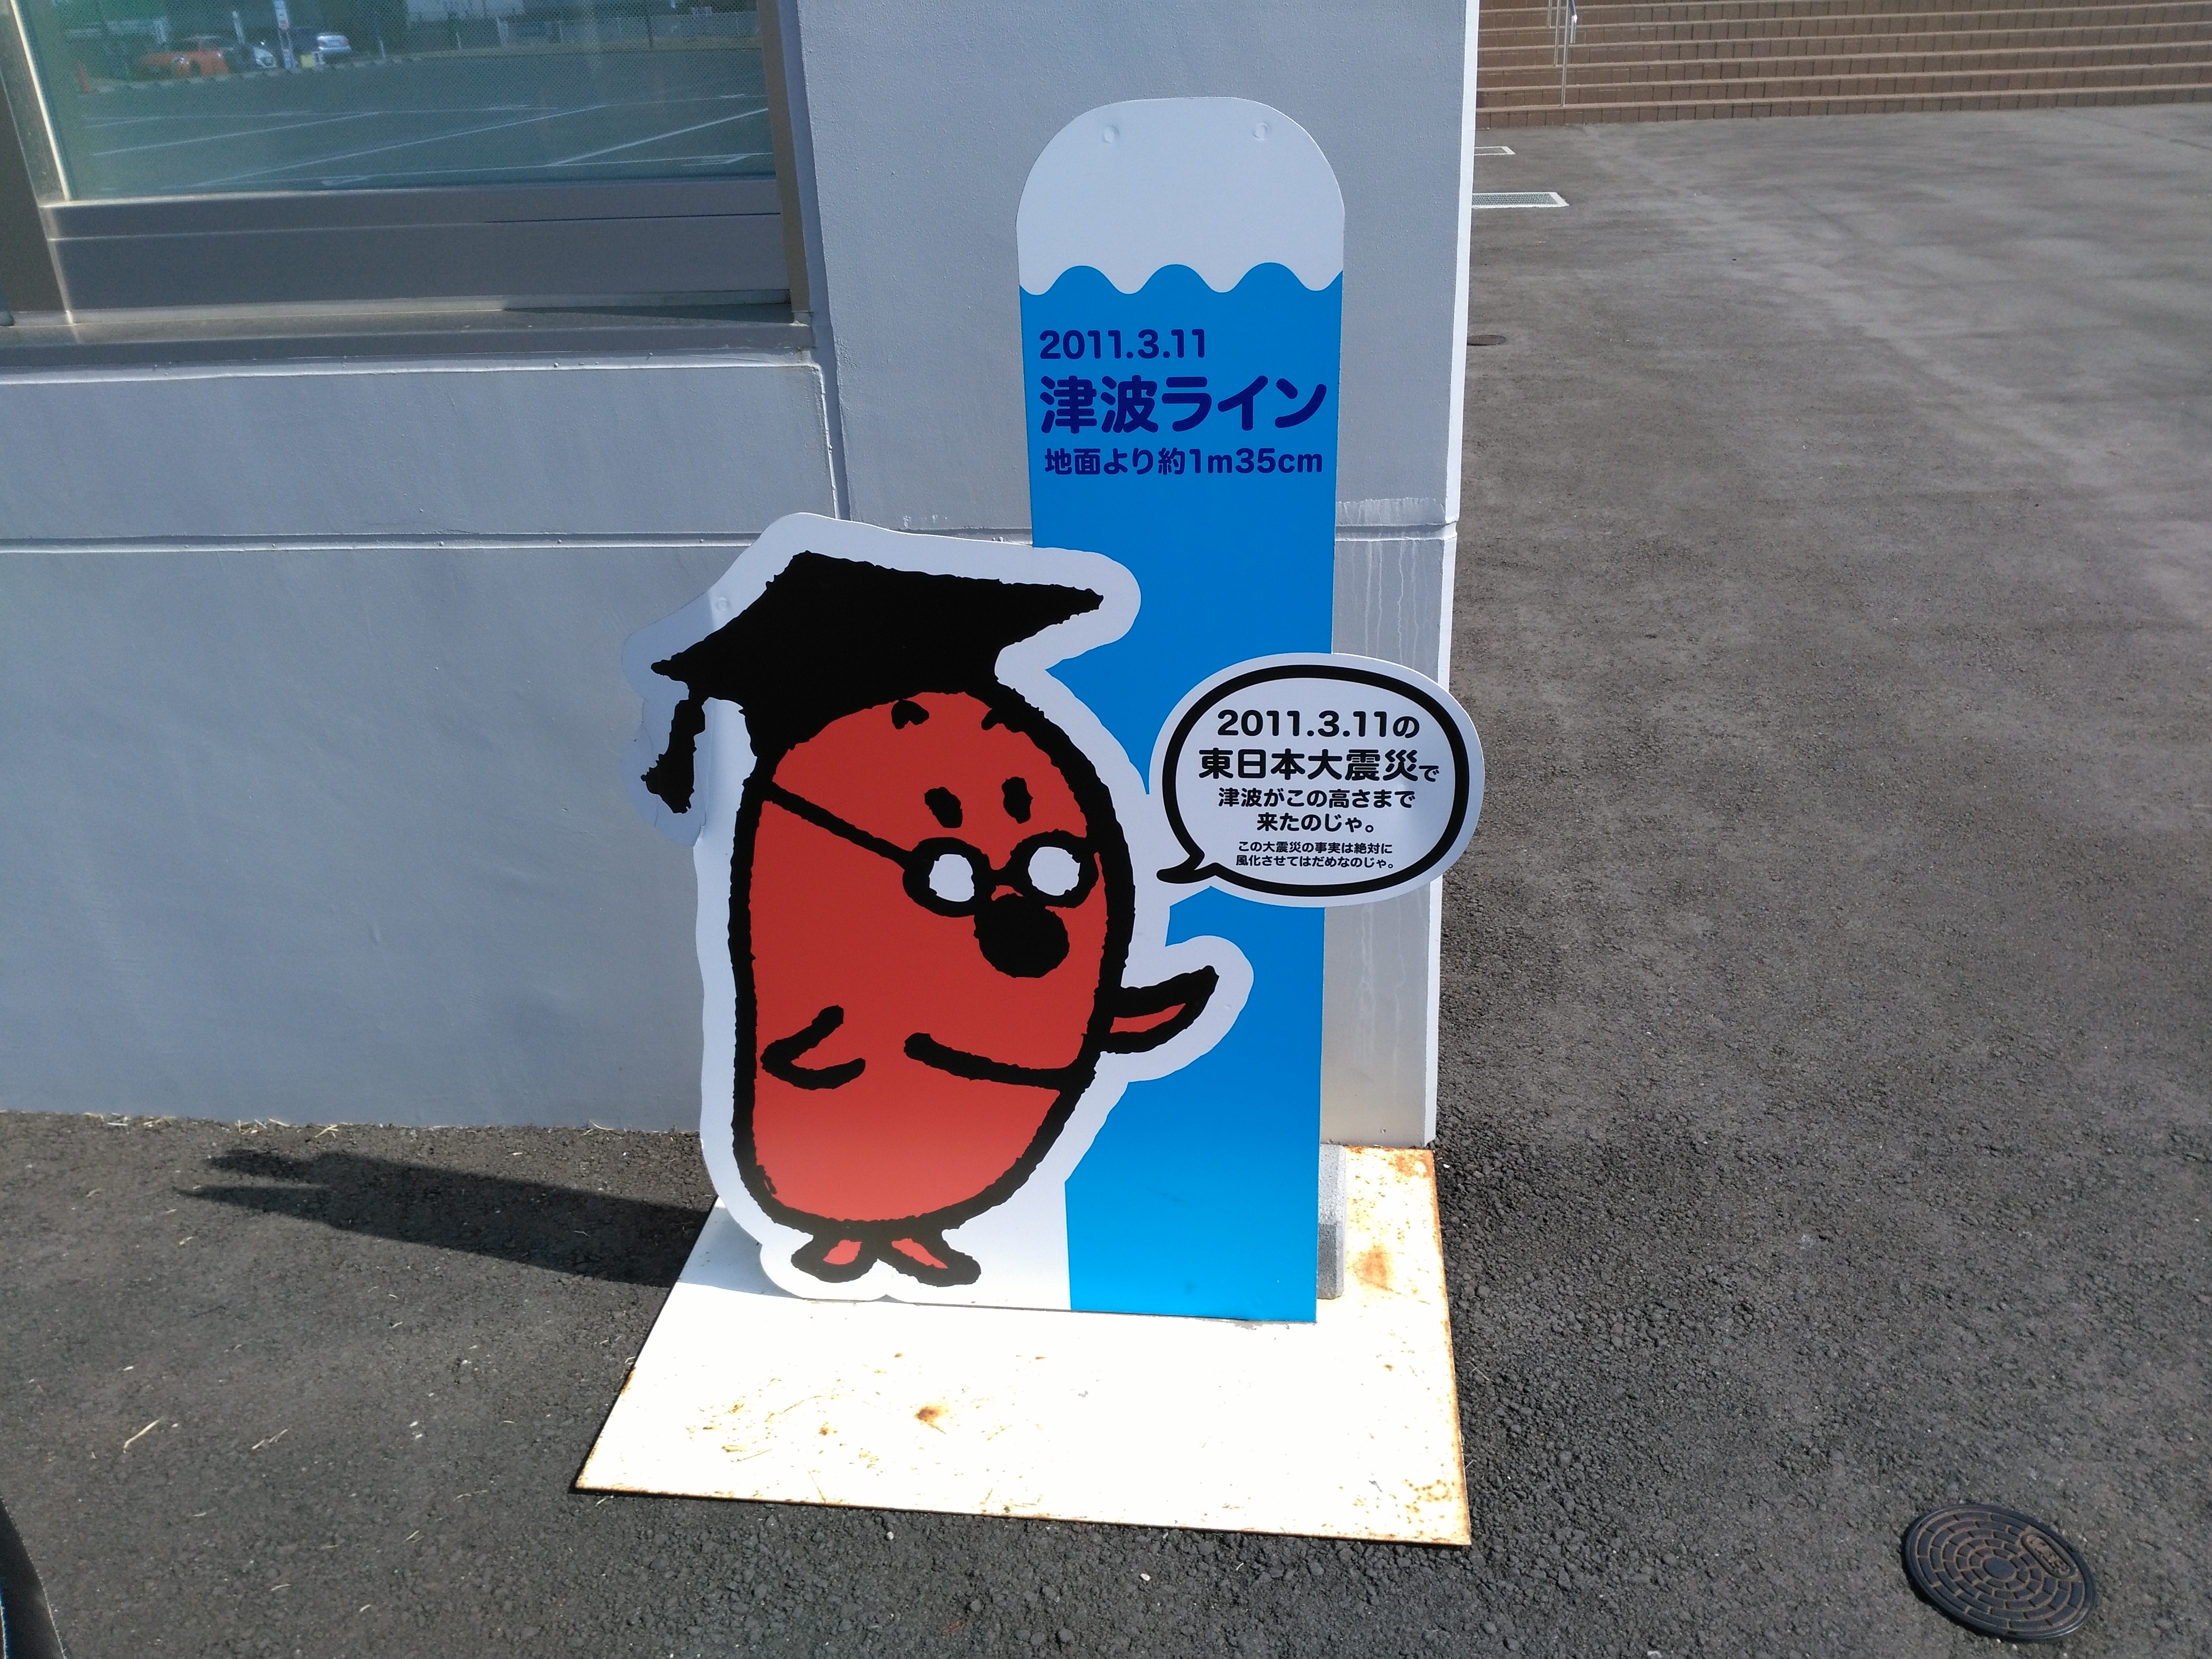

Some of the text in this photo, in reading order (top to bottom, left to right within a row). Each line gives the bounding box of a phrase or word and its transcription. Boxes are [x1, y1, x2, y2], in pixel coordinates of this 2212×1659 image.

[1039, 329, 1205, 360] 2011.3.11
[1040, 375, 1327, 433] 津波ライン
[1045, 448, 1322, 475] 地面より約1m35cm
[1217, 709, 1420, 738] 2011.3.11の
[1199, 748, 1440, 782] 東日本大震災で
[1218, 787, 1415, 809] 津波がこの高さまで
[1256, 812, 1374, 833] 来たのじゃ。
[1238, 841, 1393, 854] この大震災の事実は絶対に
[1236, 855, 1394, 869] 風化させてはだめなのじゃ。
